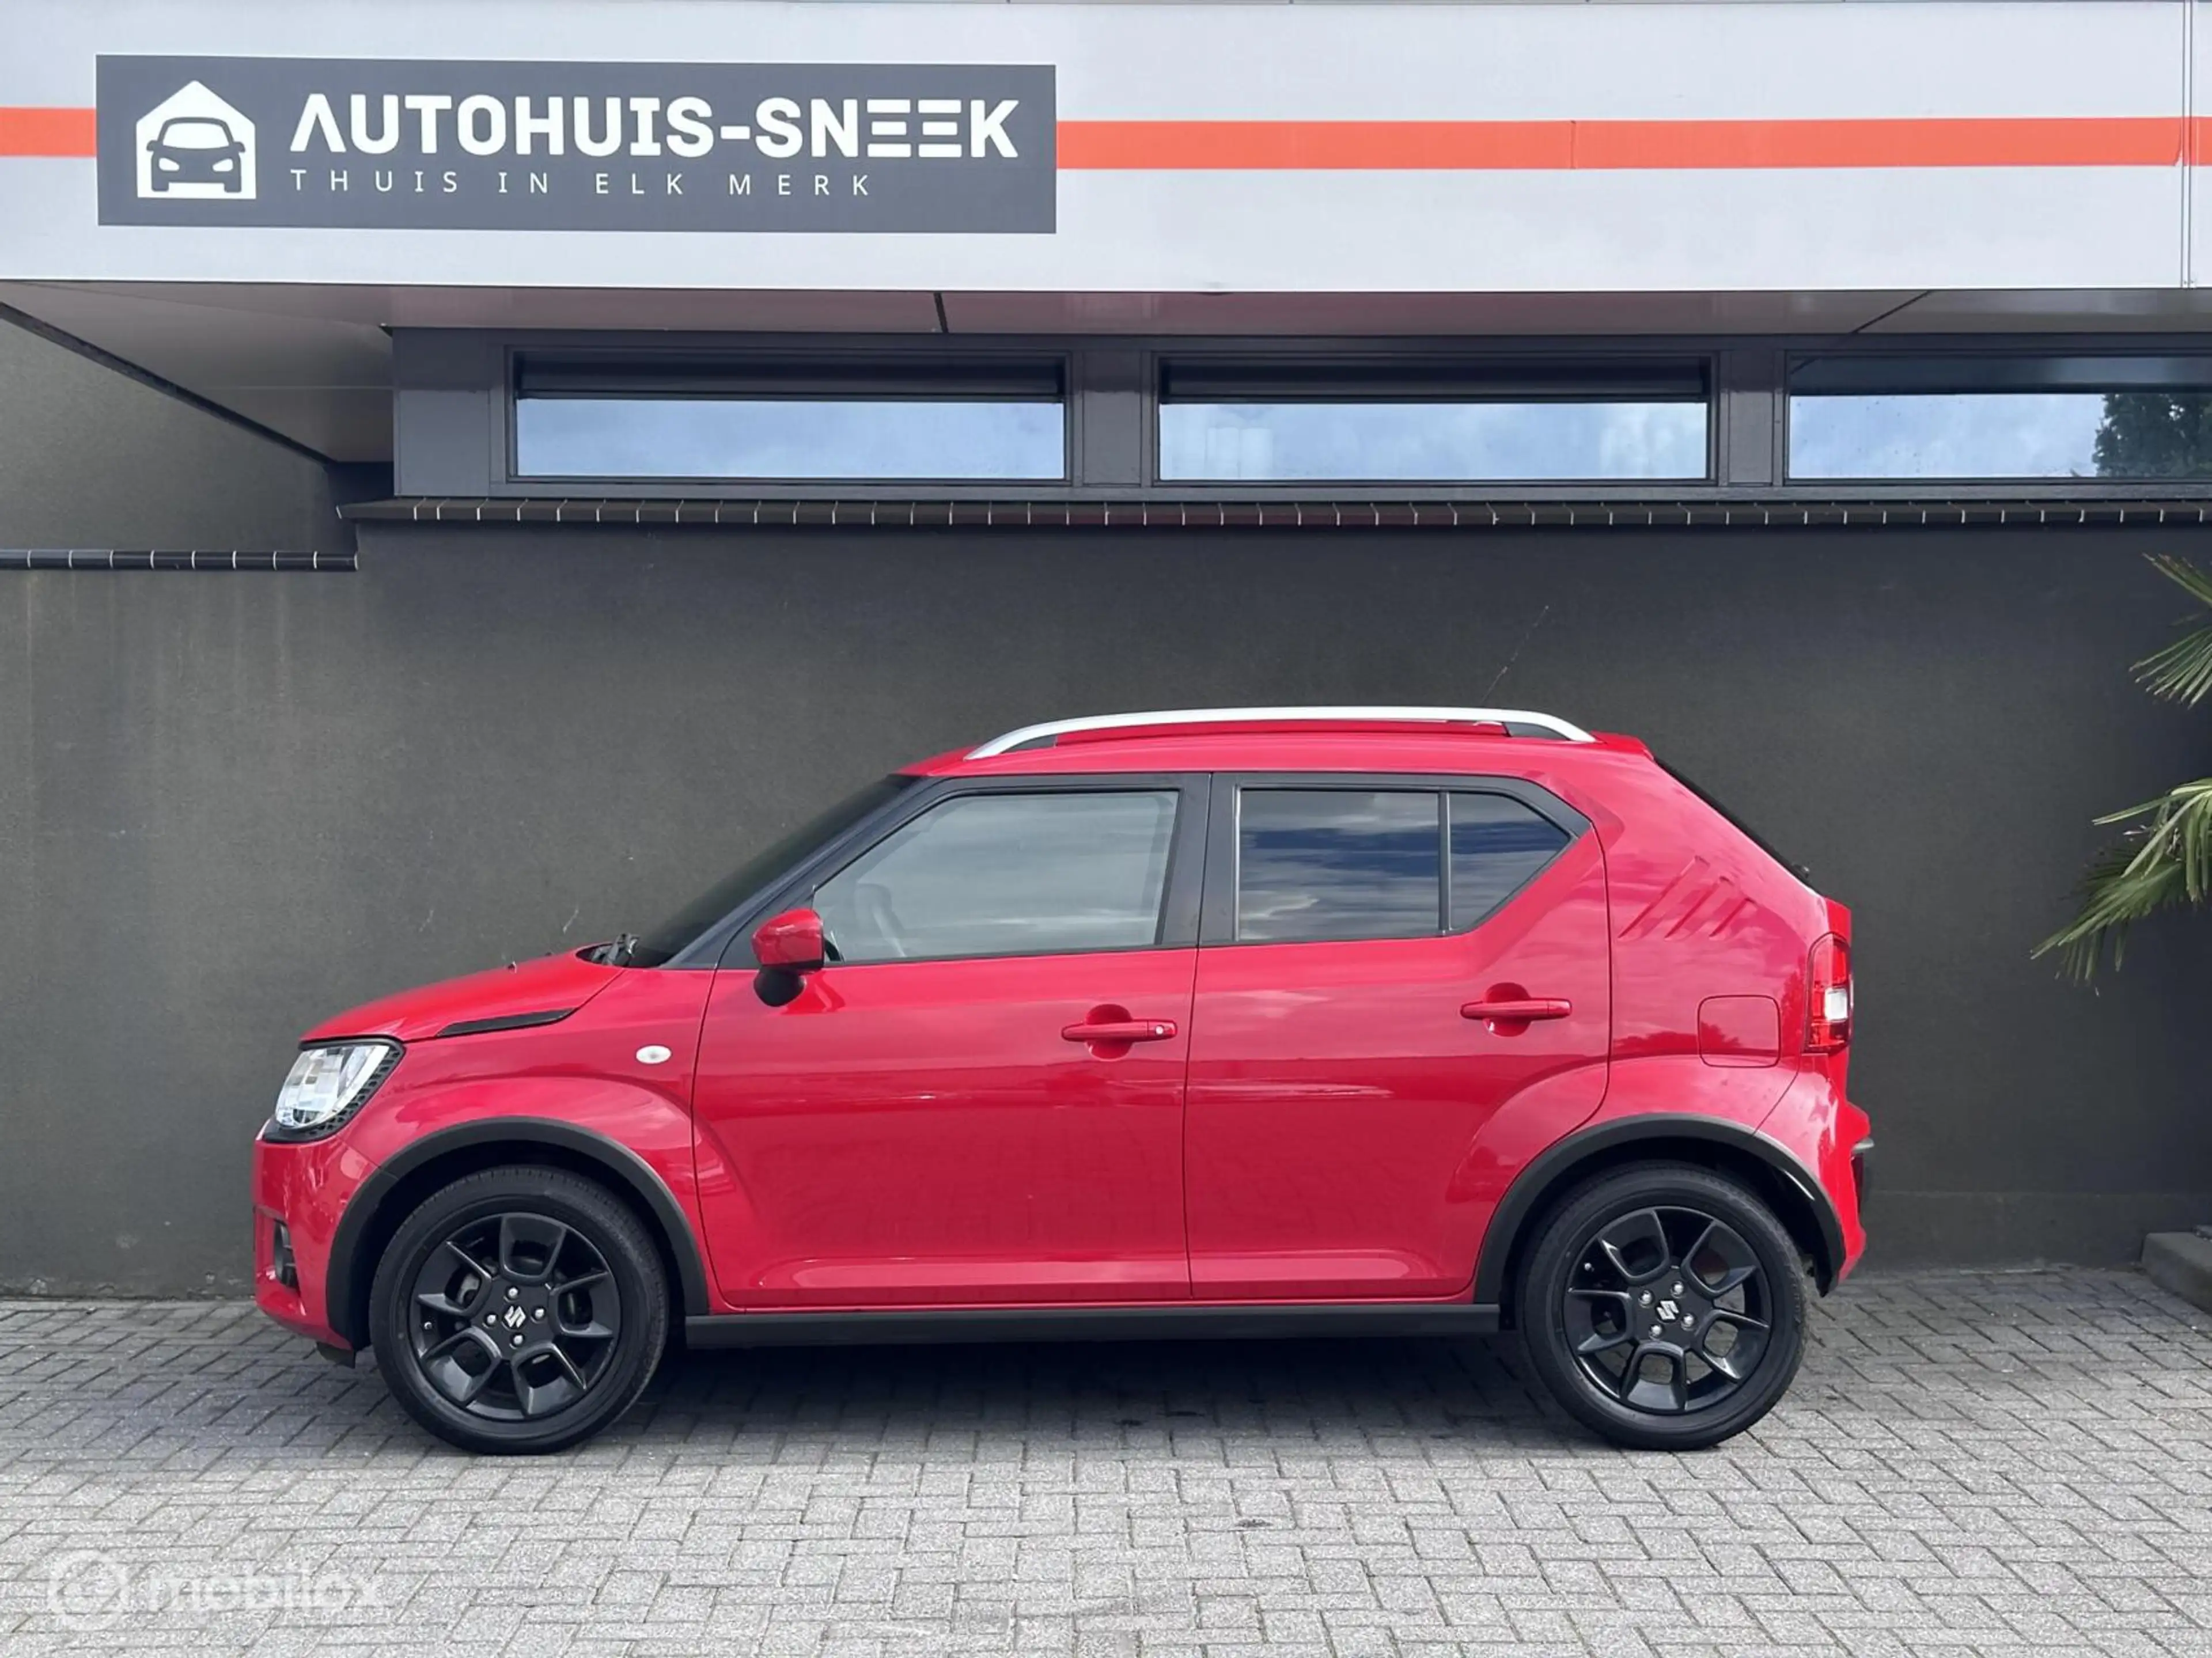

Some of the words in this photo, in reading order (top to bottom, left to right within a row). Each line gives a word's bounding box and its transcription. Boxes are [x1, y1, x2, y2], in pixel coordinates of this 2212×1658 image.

[290, 93, 1019, 158] AUTOHUIS-SNEEK
[290, 168, 459, 194] THUIS
[498, 172, 549, 194] IN
[595, 173, 684, 195] ELK
[729, 174, 869, 196] MERK
